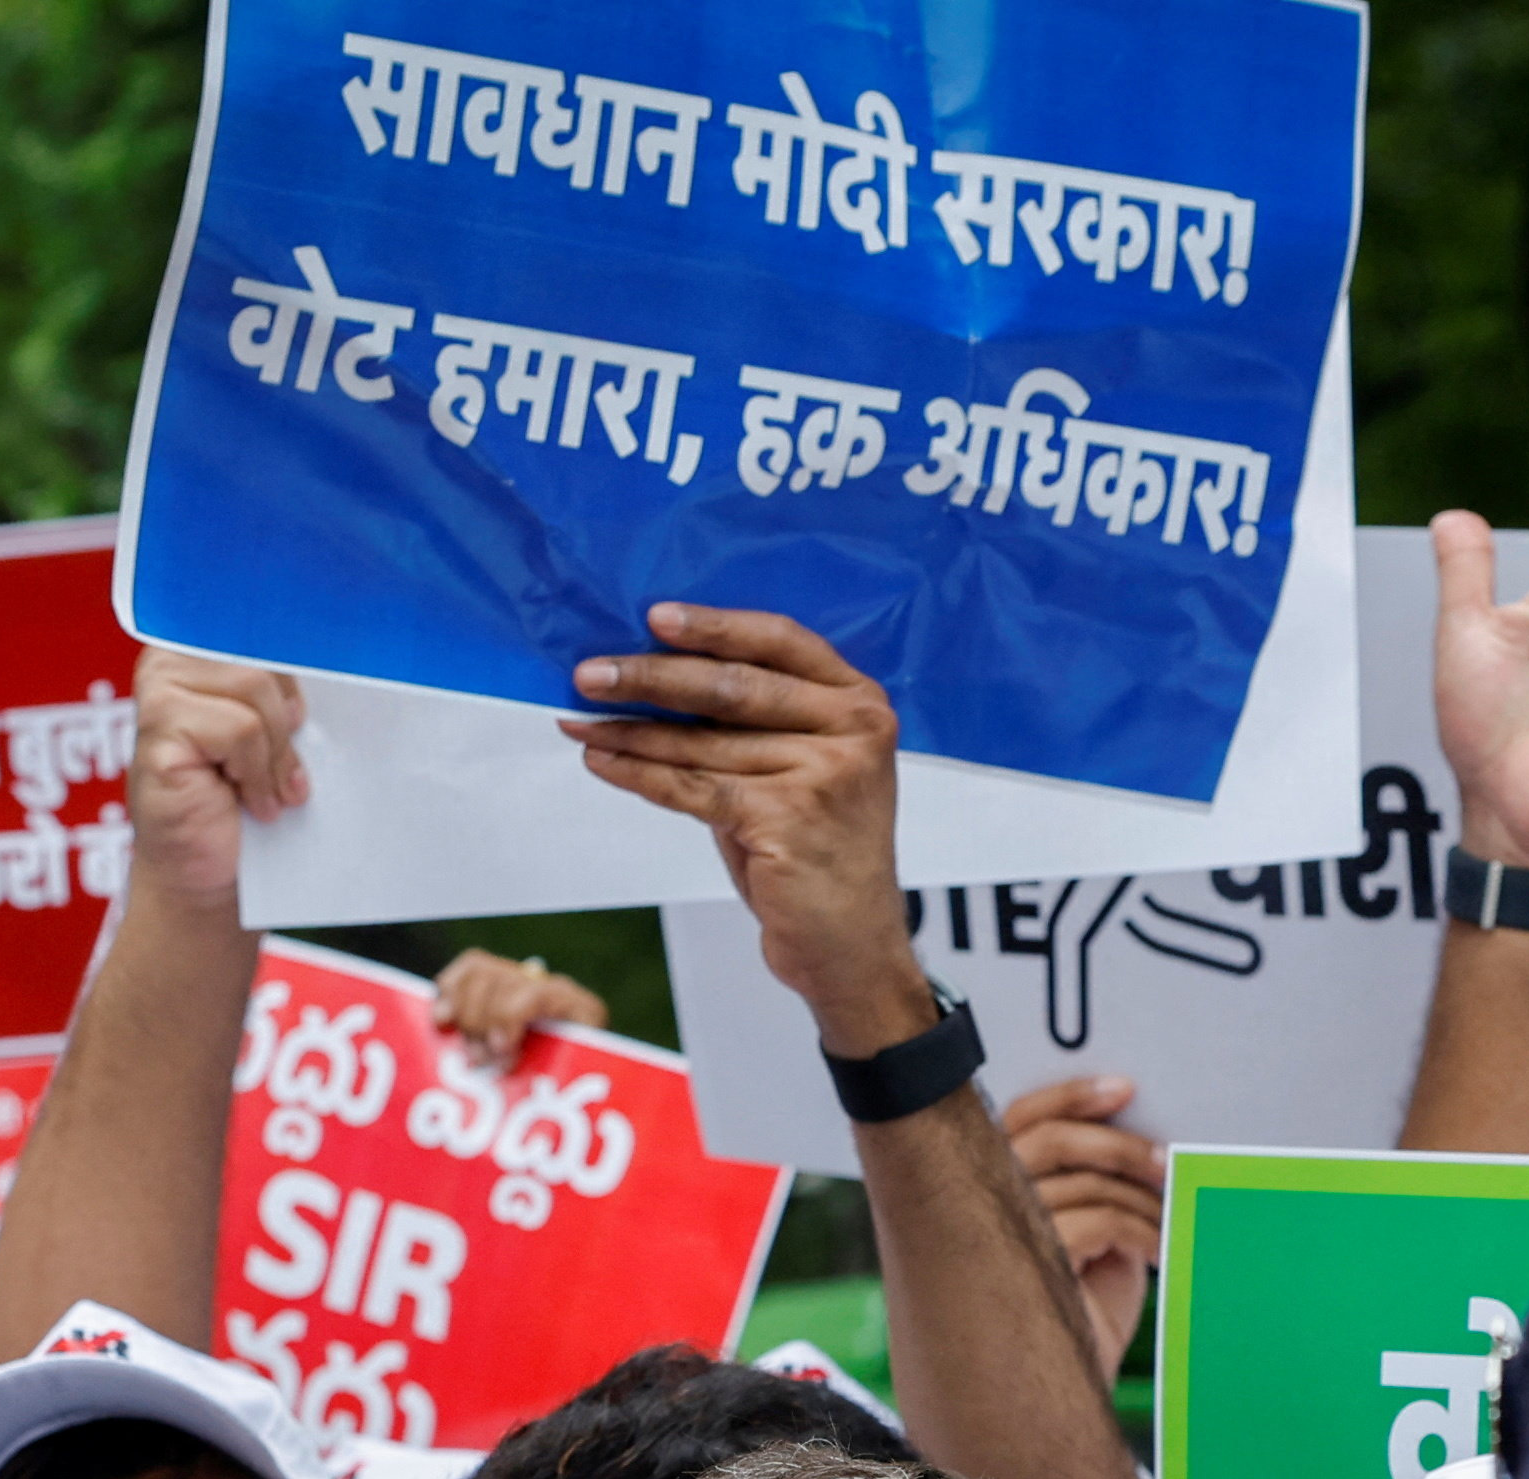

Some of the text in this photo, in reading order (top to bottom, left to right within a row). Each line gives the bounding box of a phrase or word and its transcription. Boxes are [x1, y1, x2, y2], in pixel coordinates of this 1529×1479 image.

[342, 32, 1258, 308] सावधान मोदी सरकार!
[227, 246, 1270, 557] वोट हमारा, हक़ अधिकार!
[77, 800, 134, 900] बं
[243, 1169, 467, 1343] SIR
